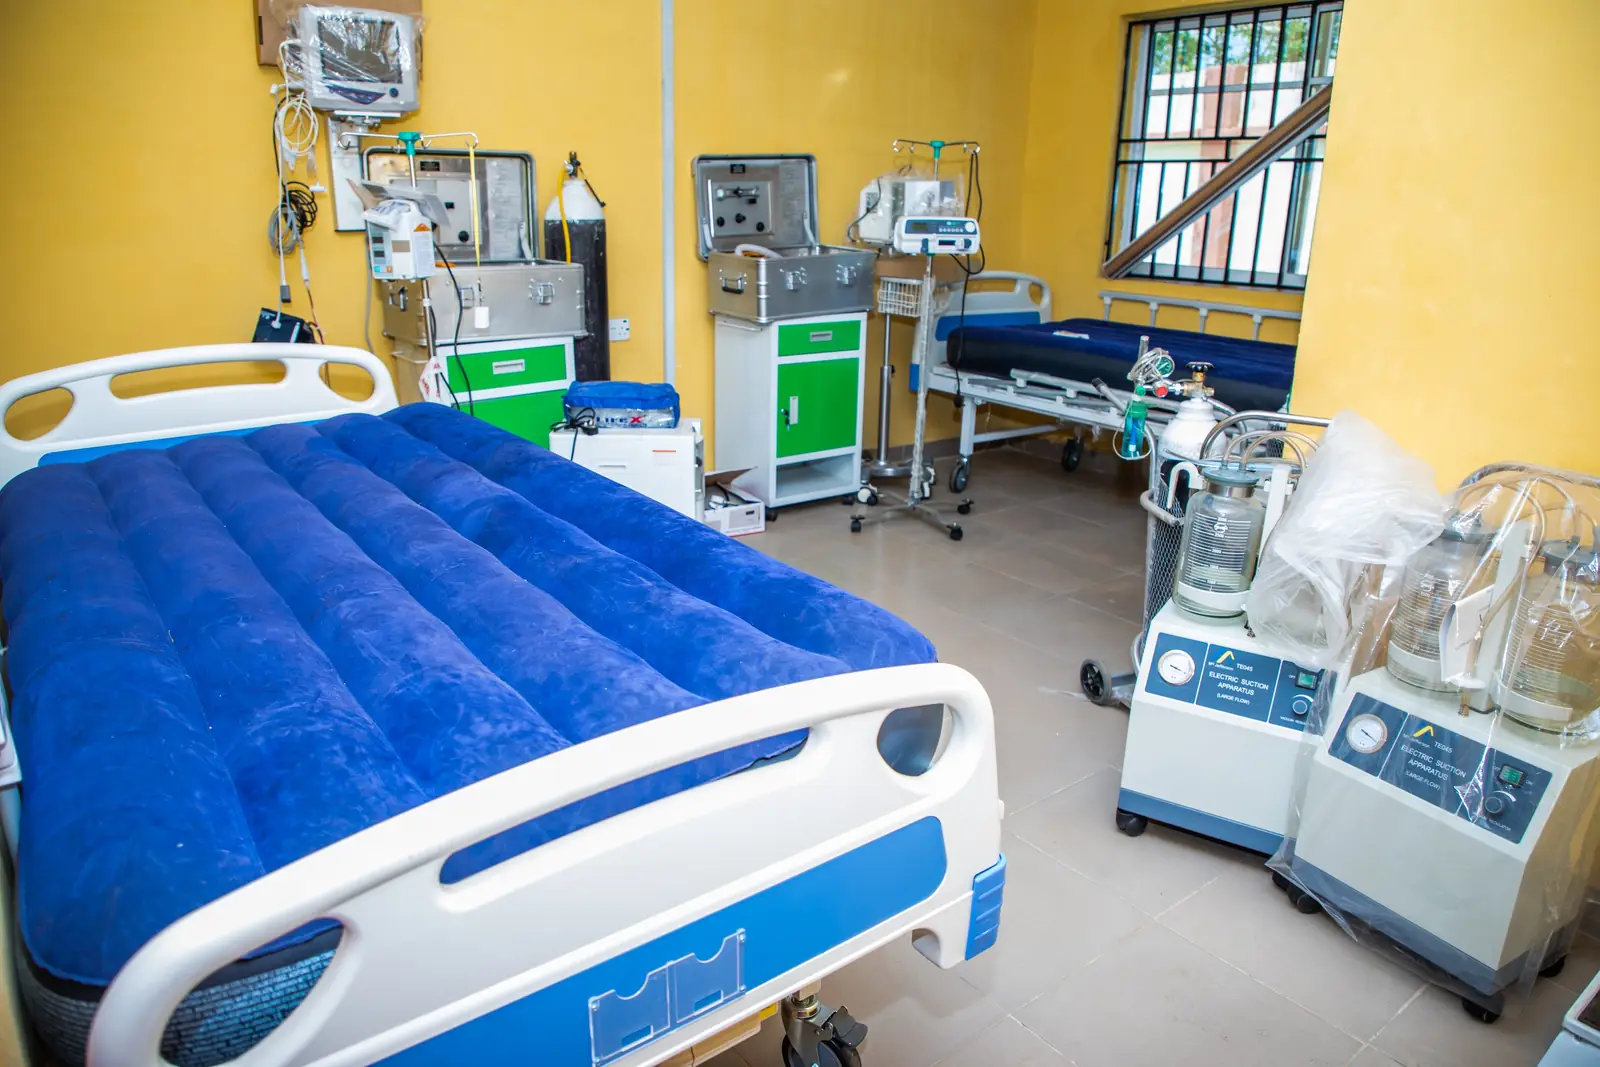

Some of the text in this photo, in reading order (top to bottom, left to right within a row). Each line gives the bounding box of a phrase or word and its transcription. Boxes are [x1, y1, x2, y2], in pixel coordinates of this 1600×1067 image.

[1236, 663, 1253, 672] TE045
[1209, 671, 1269, 690] ELECTRIC SUCTION
[1217, 682, 1255, 696] APPARATUS
[1216, 693, 1250, 706] (LARGE FLOW)
[1434, 741, 1453, 754] TE045
[1400, 744, 1467, 778] ELECTRIC SUCTION
[1408, 759, 1448, 780] APPARATUS
[1423, 778, 1441, 791] FLOW)
